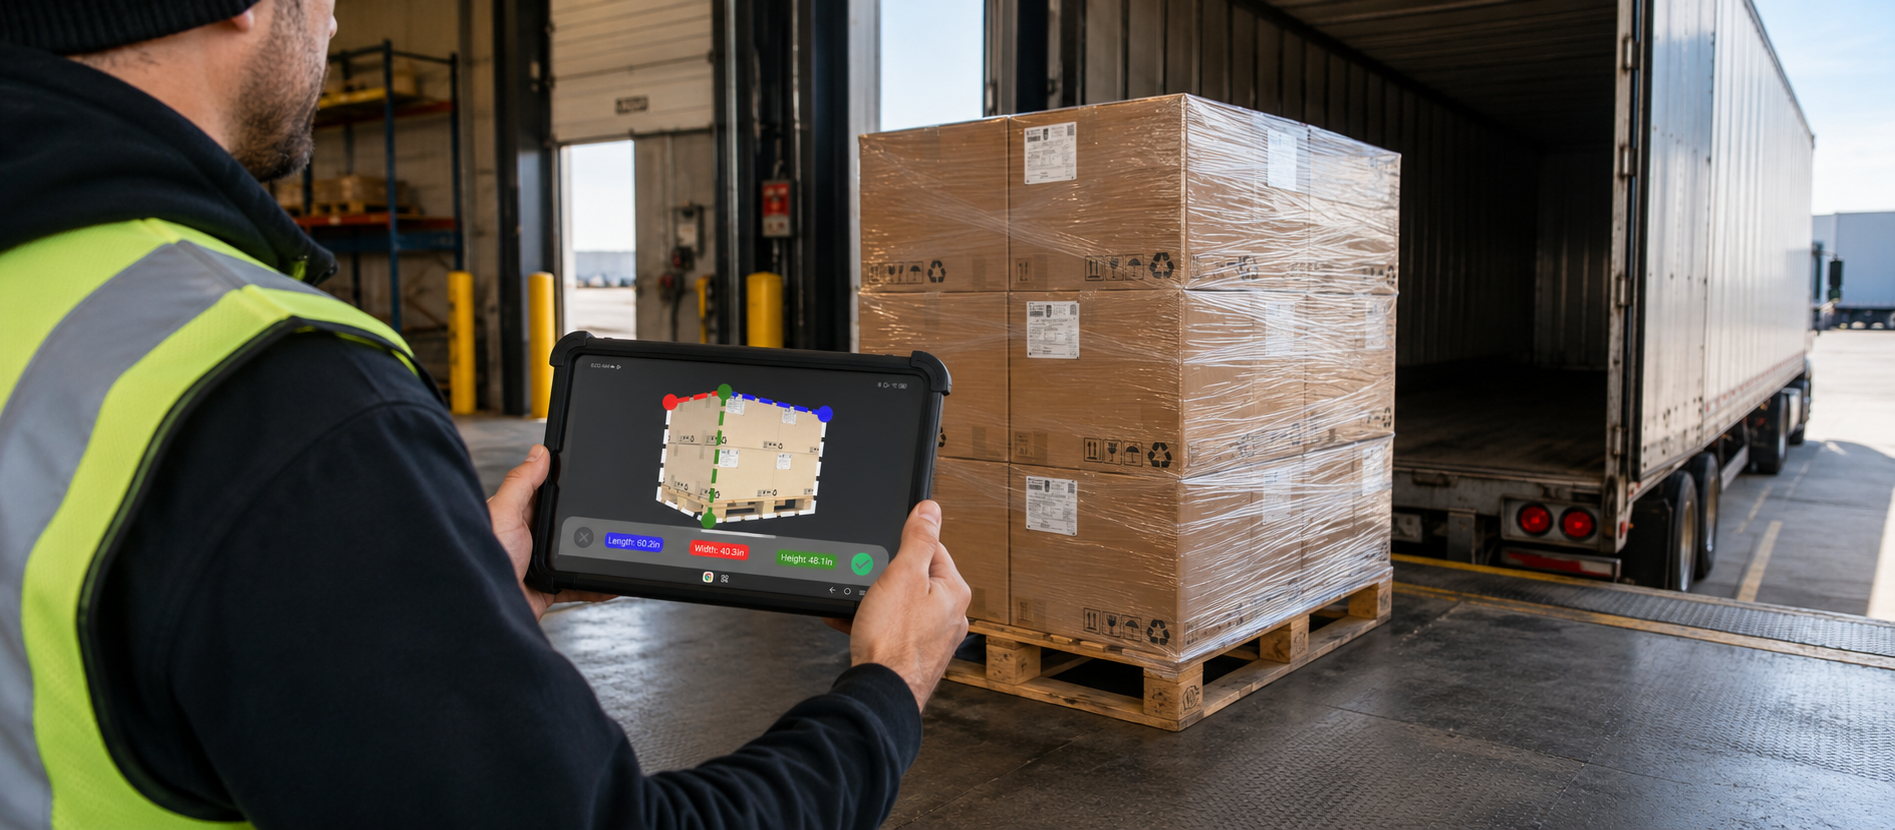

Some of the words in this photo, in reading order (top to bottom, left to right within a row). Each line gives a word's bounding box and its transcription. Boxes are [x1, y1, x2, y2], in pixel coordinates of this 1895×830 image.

[608, 536, 636, 548] Length:
[637, 539, 661, 549] 60.2in
[694, 544, 719, 554] Width:
